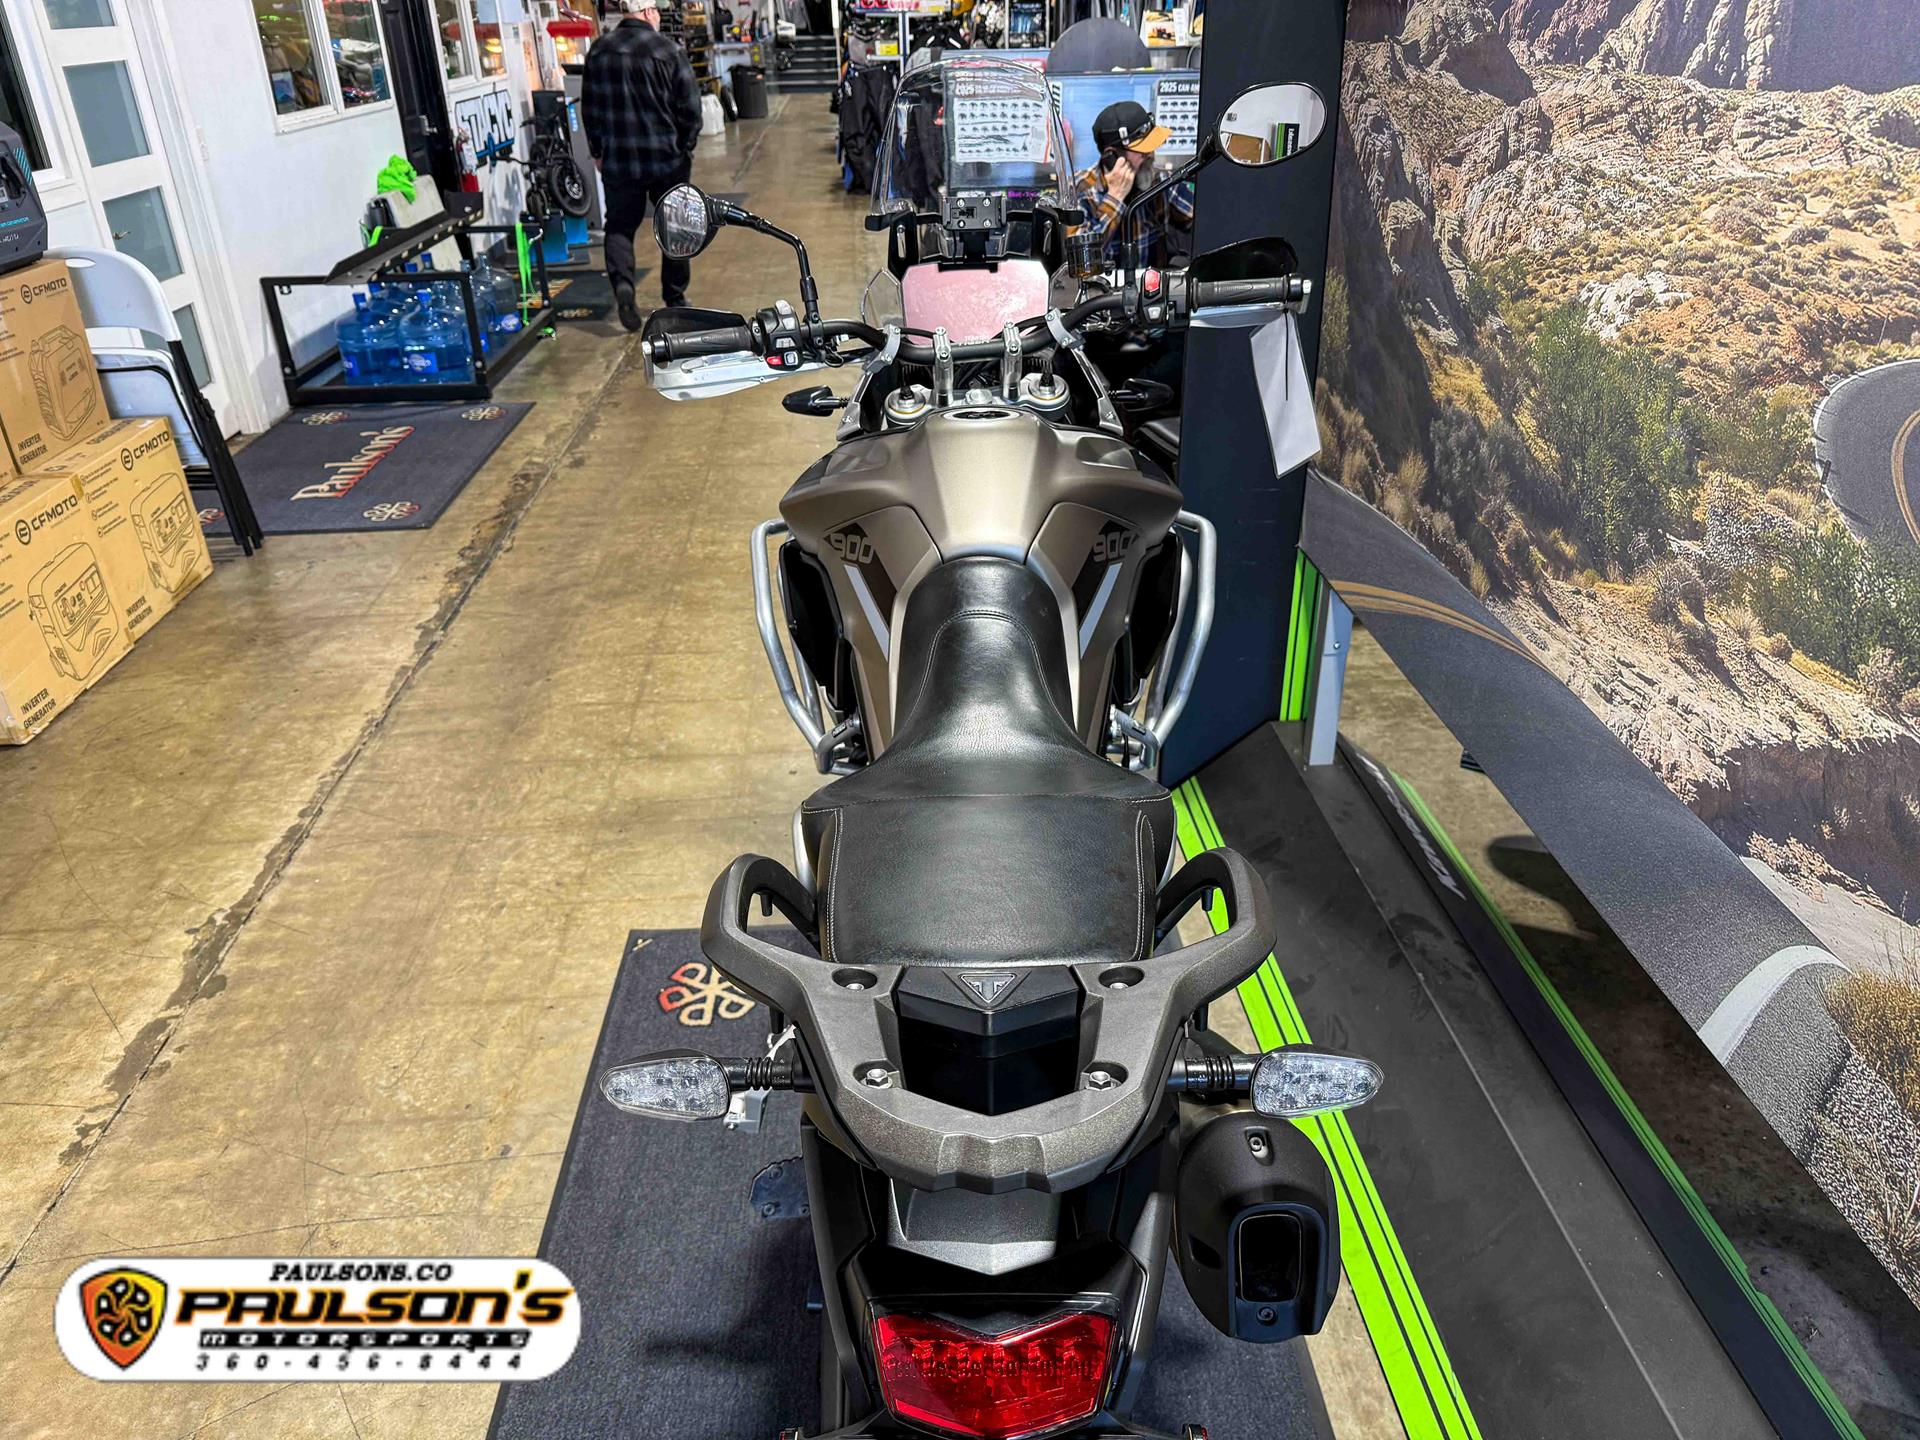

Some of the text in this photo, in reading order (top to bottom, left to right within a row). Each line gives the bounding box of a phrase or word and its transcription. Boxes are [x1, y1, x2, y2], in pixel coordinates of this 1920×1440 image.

[1160, 81, 1178, 93] 2025
[32, 277, 68, 297] CFMOTO
[17, 432, 42, 452] INVERTER
[19, 444, 48, 466] GENERATOR
[133, 430, 170, 460] CFMOTO
[290, 425, 416, 501] Paulson's
[30, 494, 79, 532] CFMOTO
[830, 533, 874, 565] 900
[128, 605, 153, 630] GENERATOR
[20, 687, 50, 715] INVERTER
[23, 698, 57, 730] GENERATOR
